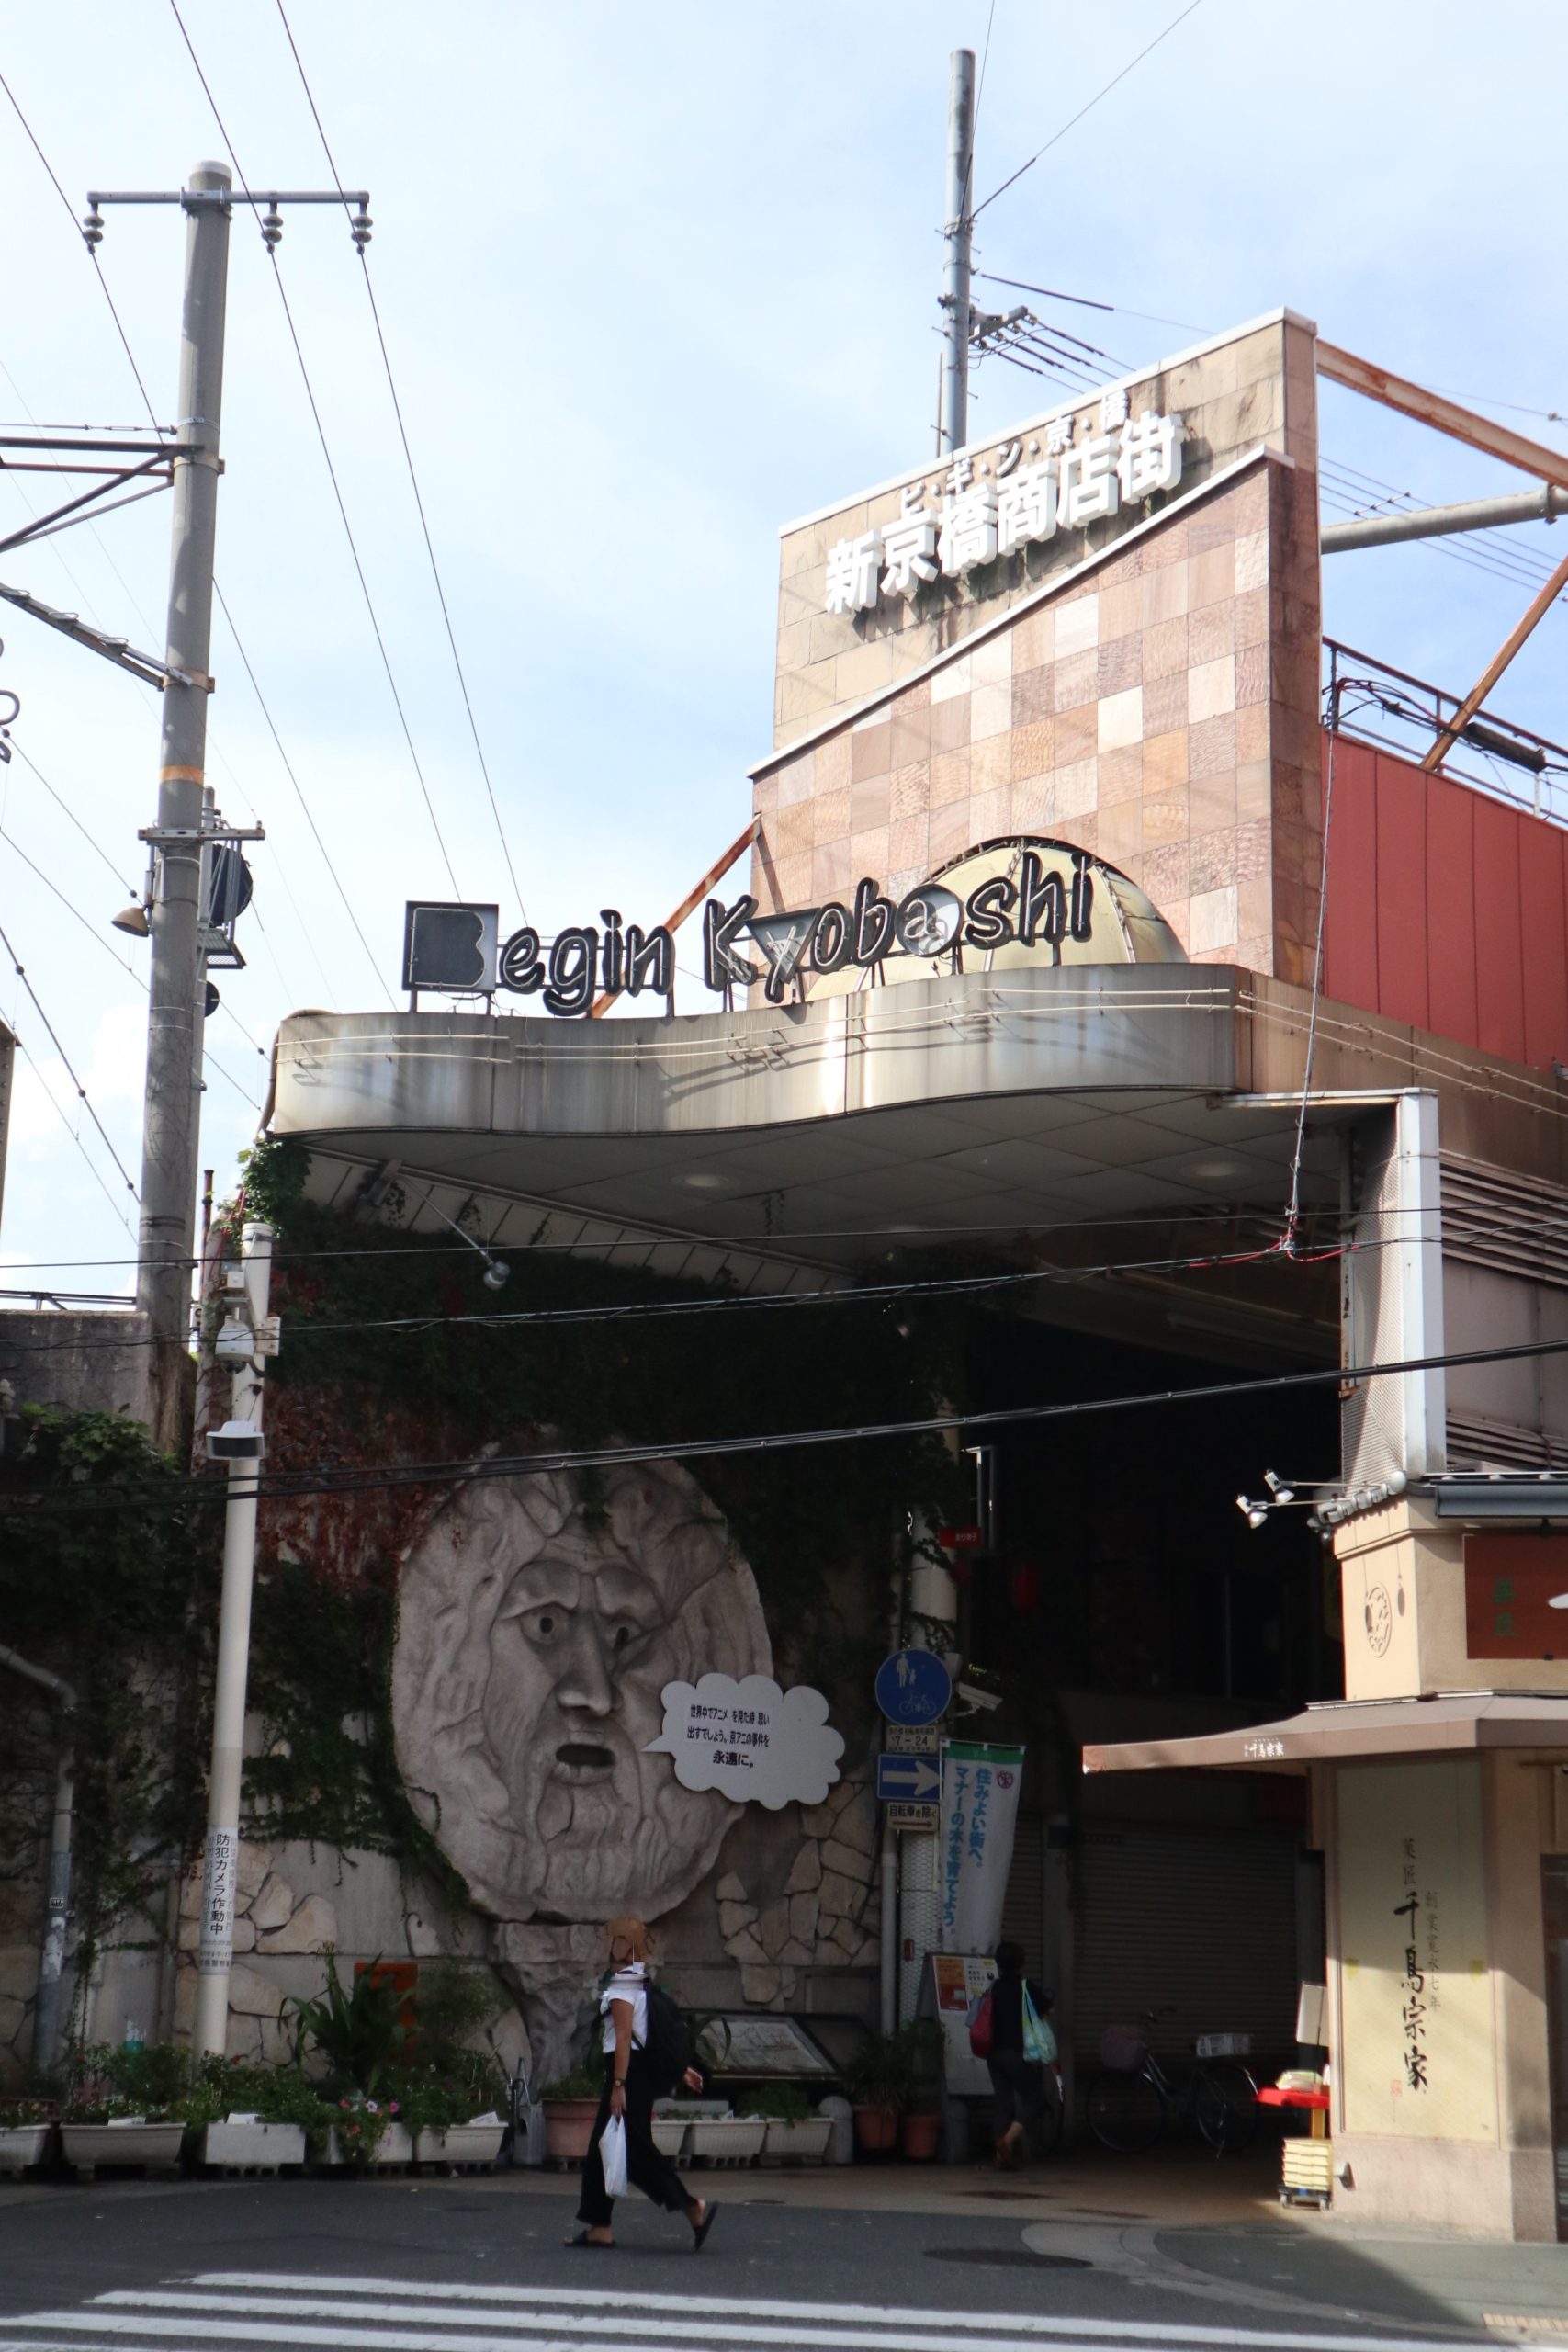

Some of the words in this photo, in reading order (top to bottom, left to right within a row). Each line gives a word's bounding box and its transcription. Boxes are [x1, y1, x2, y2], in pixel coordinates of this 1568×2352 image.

[825, 410, 1186, 615] 新京橋商店街
[405, 900, 675, 1018] Begin
[704, 851, 1095, 1003] Kyobashi
[713, 1750, 754, 1768] 永遠に。
[889, 1804, 936, 1818] 自転車を除く
[968, 1767, 993, 1869] 住みよい街へ。
[210, 1834, 230, 1935] 防犯カメラ作動中
